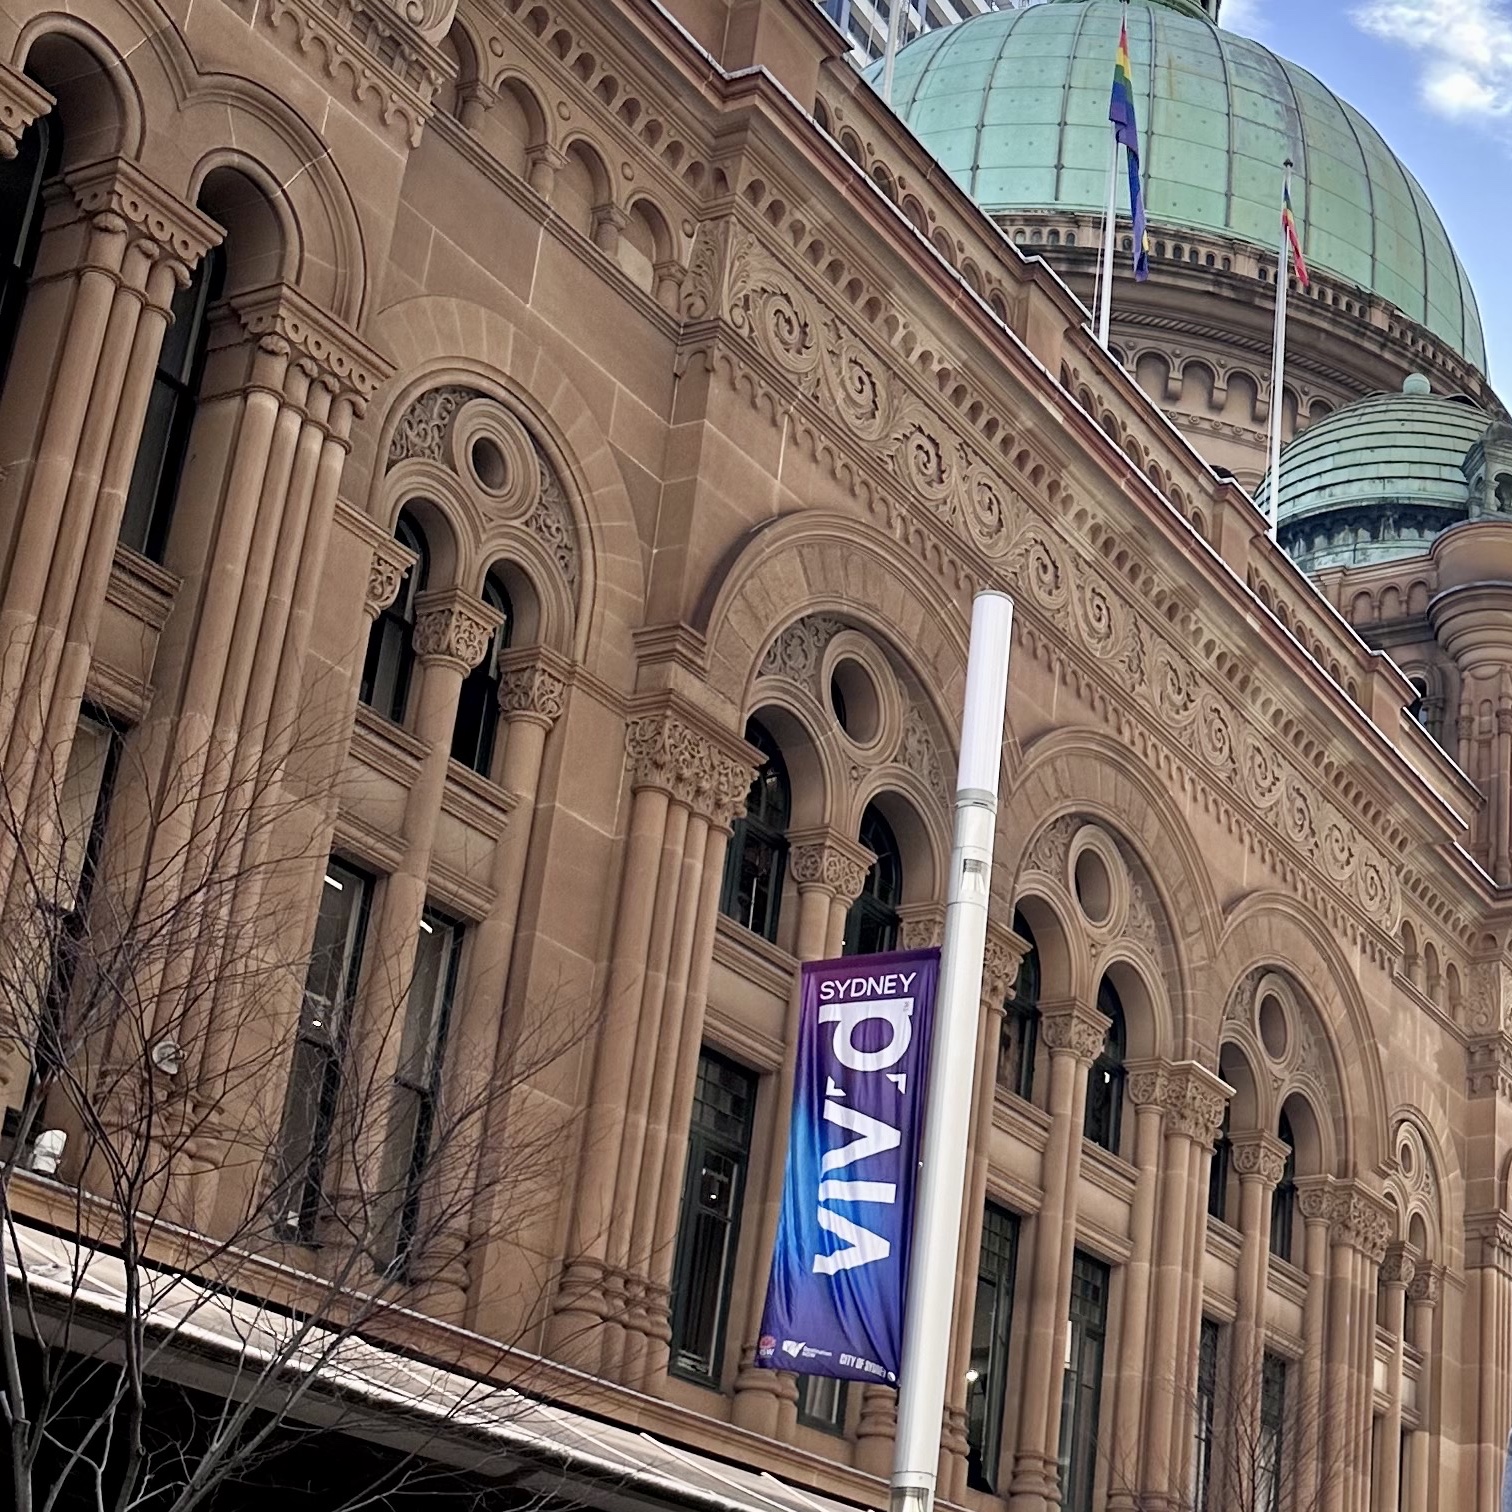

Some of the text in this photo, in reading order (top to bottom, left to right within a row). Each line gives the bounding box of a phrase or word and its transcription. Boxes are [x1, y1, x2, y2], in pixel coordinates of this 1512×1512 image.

[819, 972, 917, 1000] SYDNEY
[839, 1353, 856, 1368] CITY
[855, 1357, 865, 1369] OF
